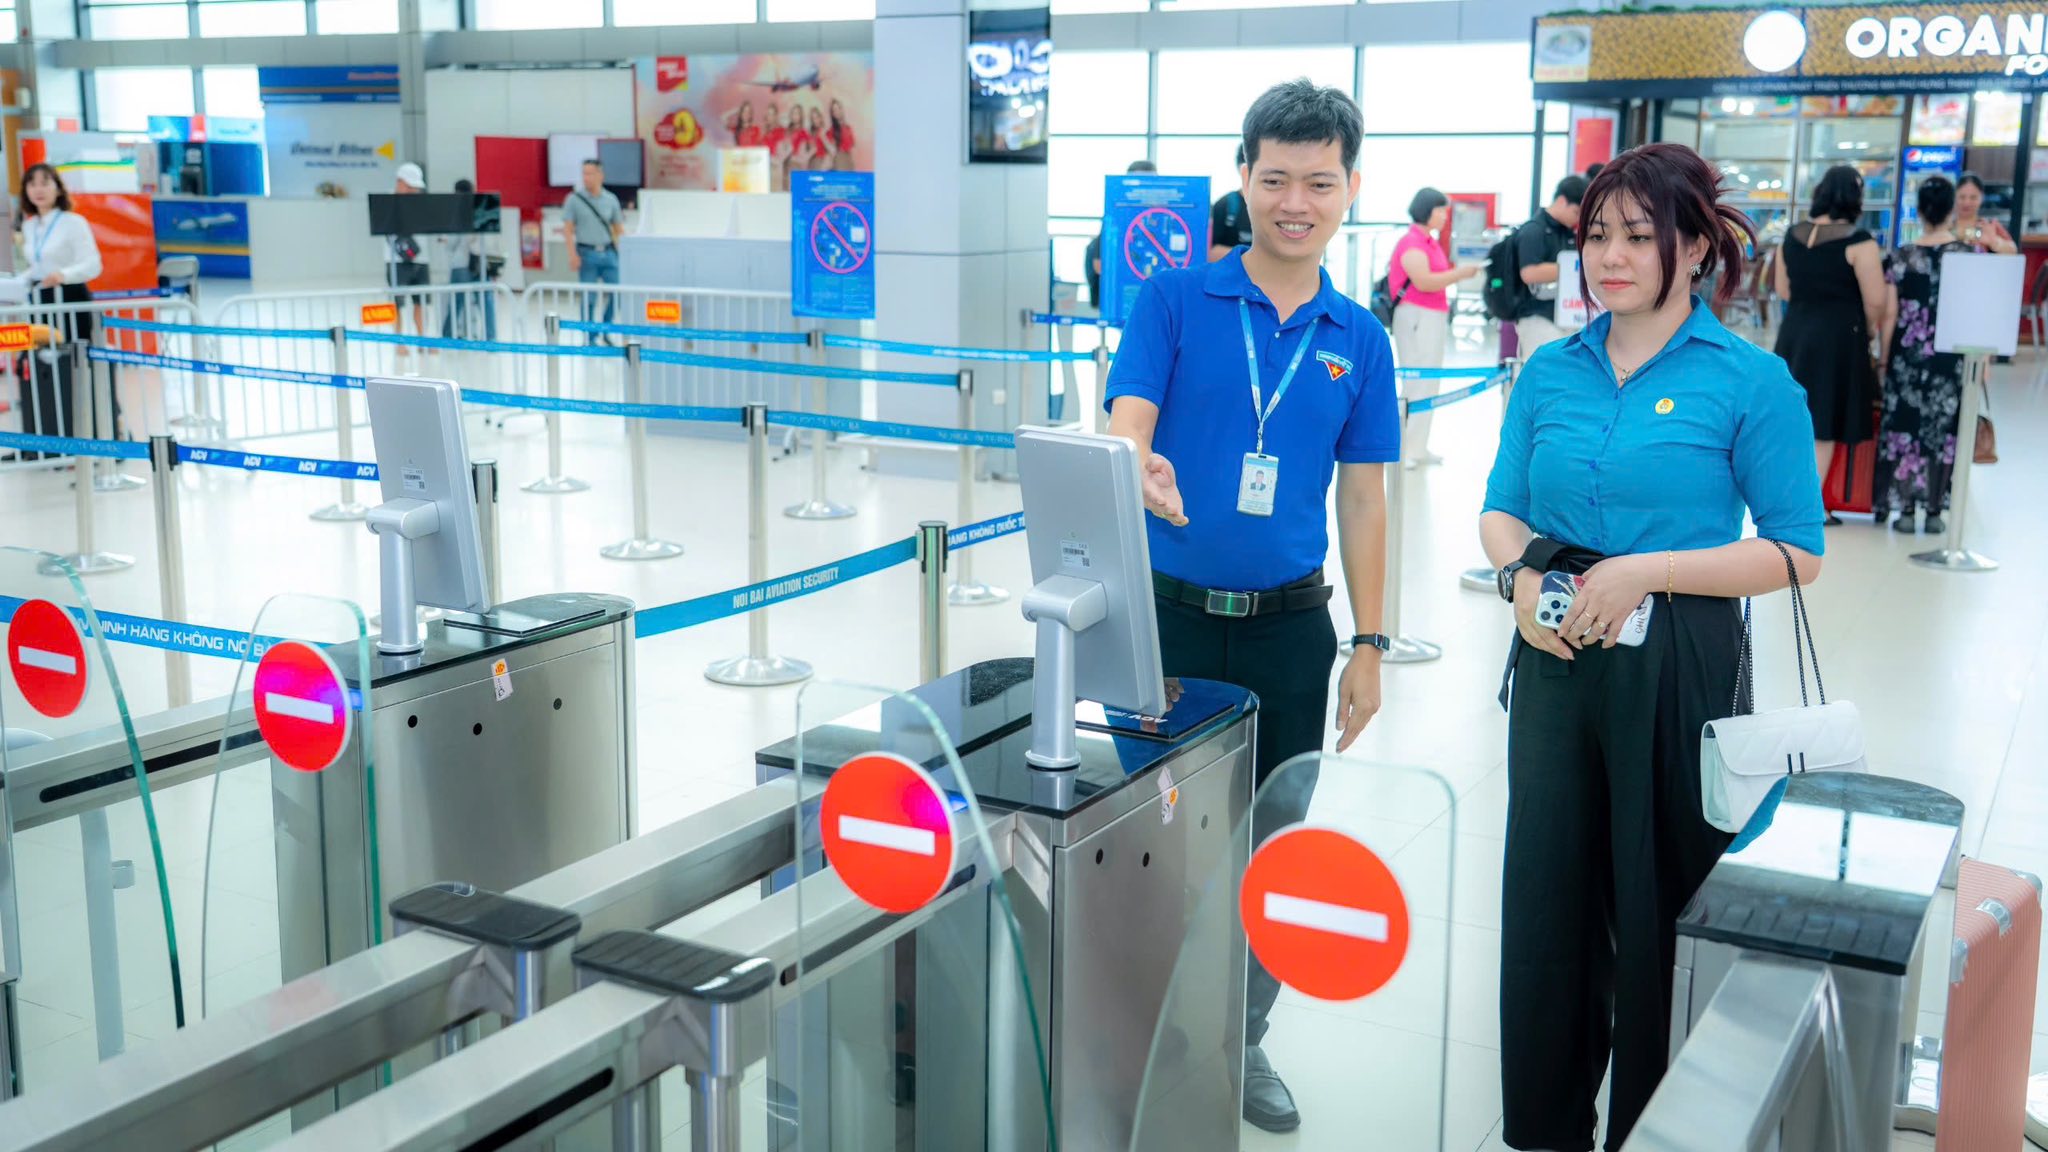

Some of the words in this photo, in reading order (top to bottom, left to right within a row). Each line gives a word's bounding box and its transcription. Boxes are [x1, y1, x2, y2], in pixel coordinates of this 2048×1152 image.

[1846, 13, 2048, 58] ORGAN
[190, 449, 208, 461] ACV
[243, 454, 261, 467] ACV
[298, 460, 317, 473] ACV
[356, 464, 376, 477] ACV
[733, 592, 748, 609] NOI
[750, 588, 764, 604] BAI
[765, 577, 801, 600] AVIATION
[803, 566, 839, 589] SECURITY
[130, 622, 170, 642] HÀNG
[173, 629, 224, 651] KHÔNG
